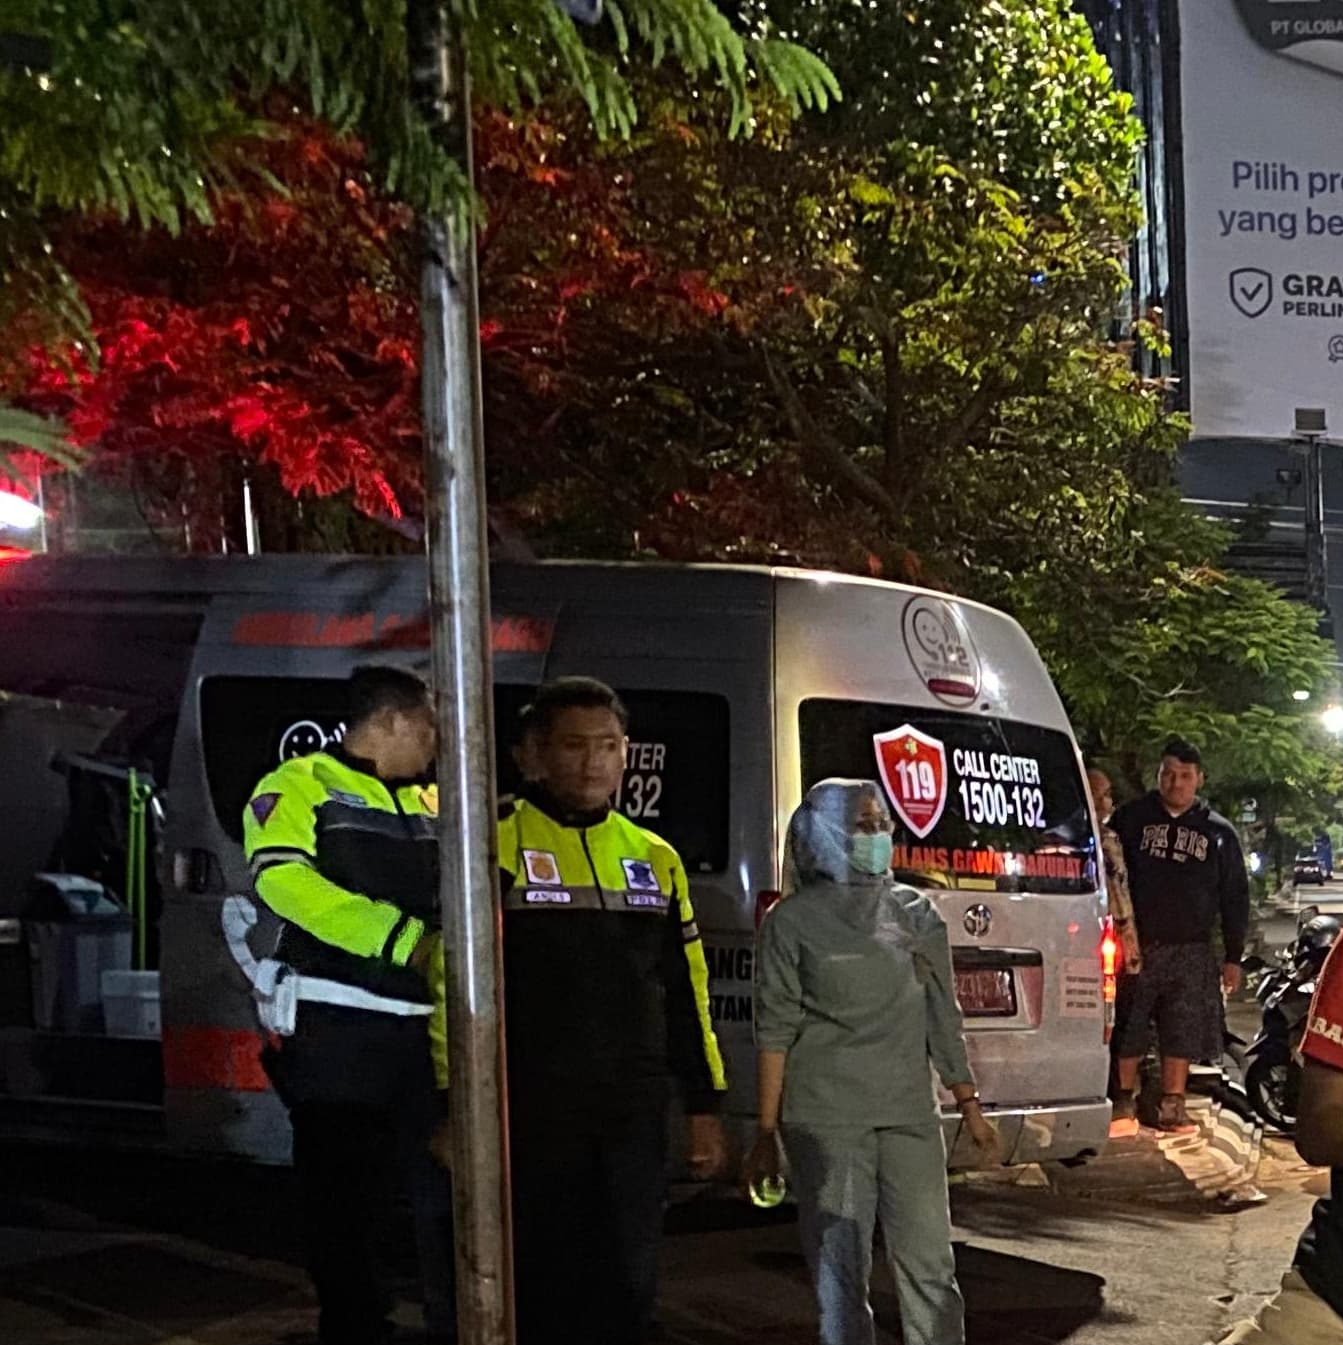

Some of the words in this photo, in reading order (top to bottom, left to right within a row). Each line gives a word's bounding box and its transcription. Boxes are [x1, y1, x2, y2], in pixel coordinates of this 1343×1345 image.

[1271, 20, 1289, 35] PT
[1232, 160, 1299, 192] Pilih
[1218, 209, 1297, 241] yang
[895, 758, 937, 801] 119
[952, 748, 991, 779] CALL
[989, 751, 1041, 785] CENTER
[958, 779, 1047, 829] 1500-132
